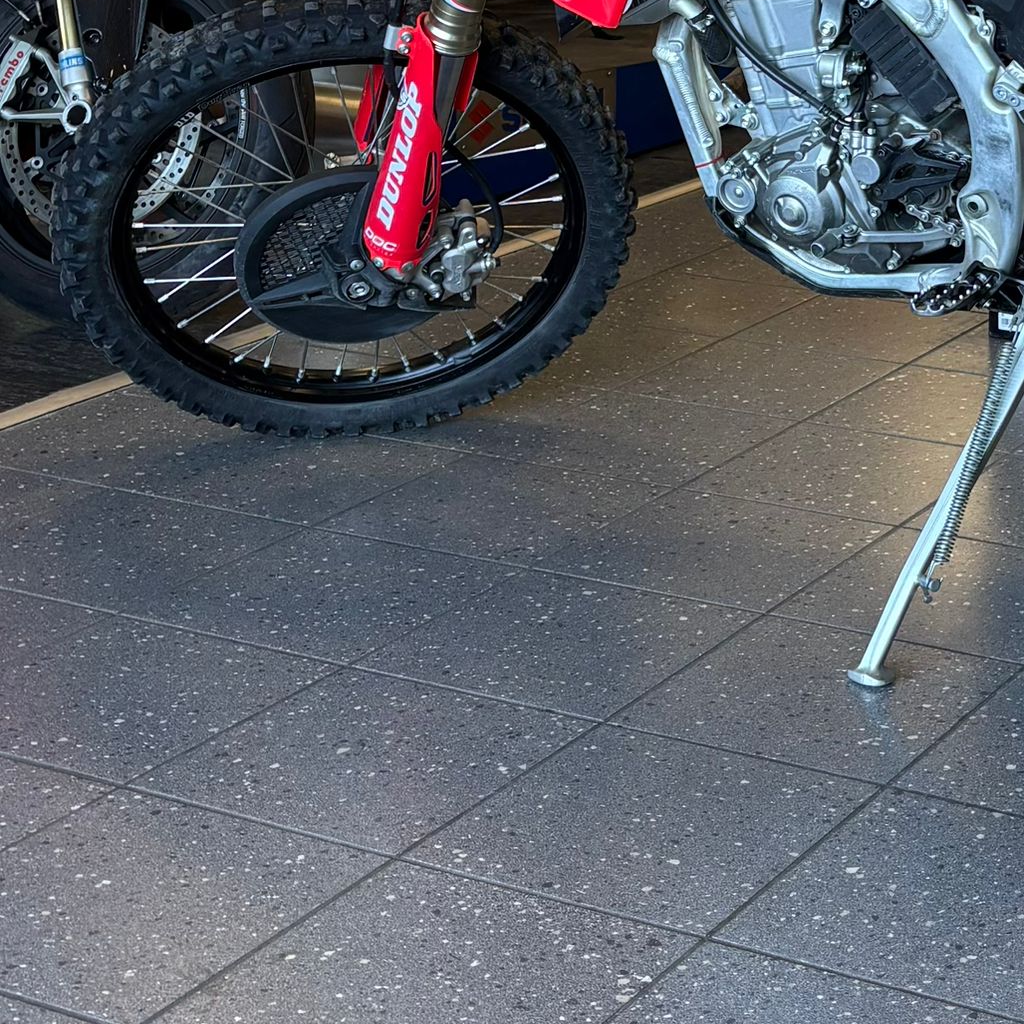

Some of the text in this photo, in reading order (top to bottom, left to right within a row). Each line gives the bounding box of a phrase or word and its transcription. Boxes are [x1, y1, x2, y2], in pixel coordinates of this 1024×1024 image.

[0, 50, 25, 86] embo
[376, 81, 423, 232] DUNLOP
[365, 227, 398, 252] DOC
